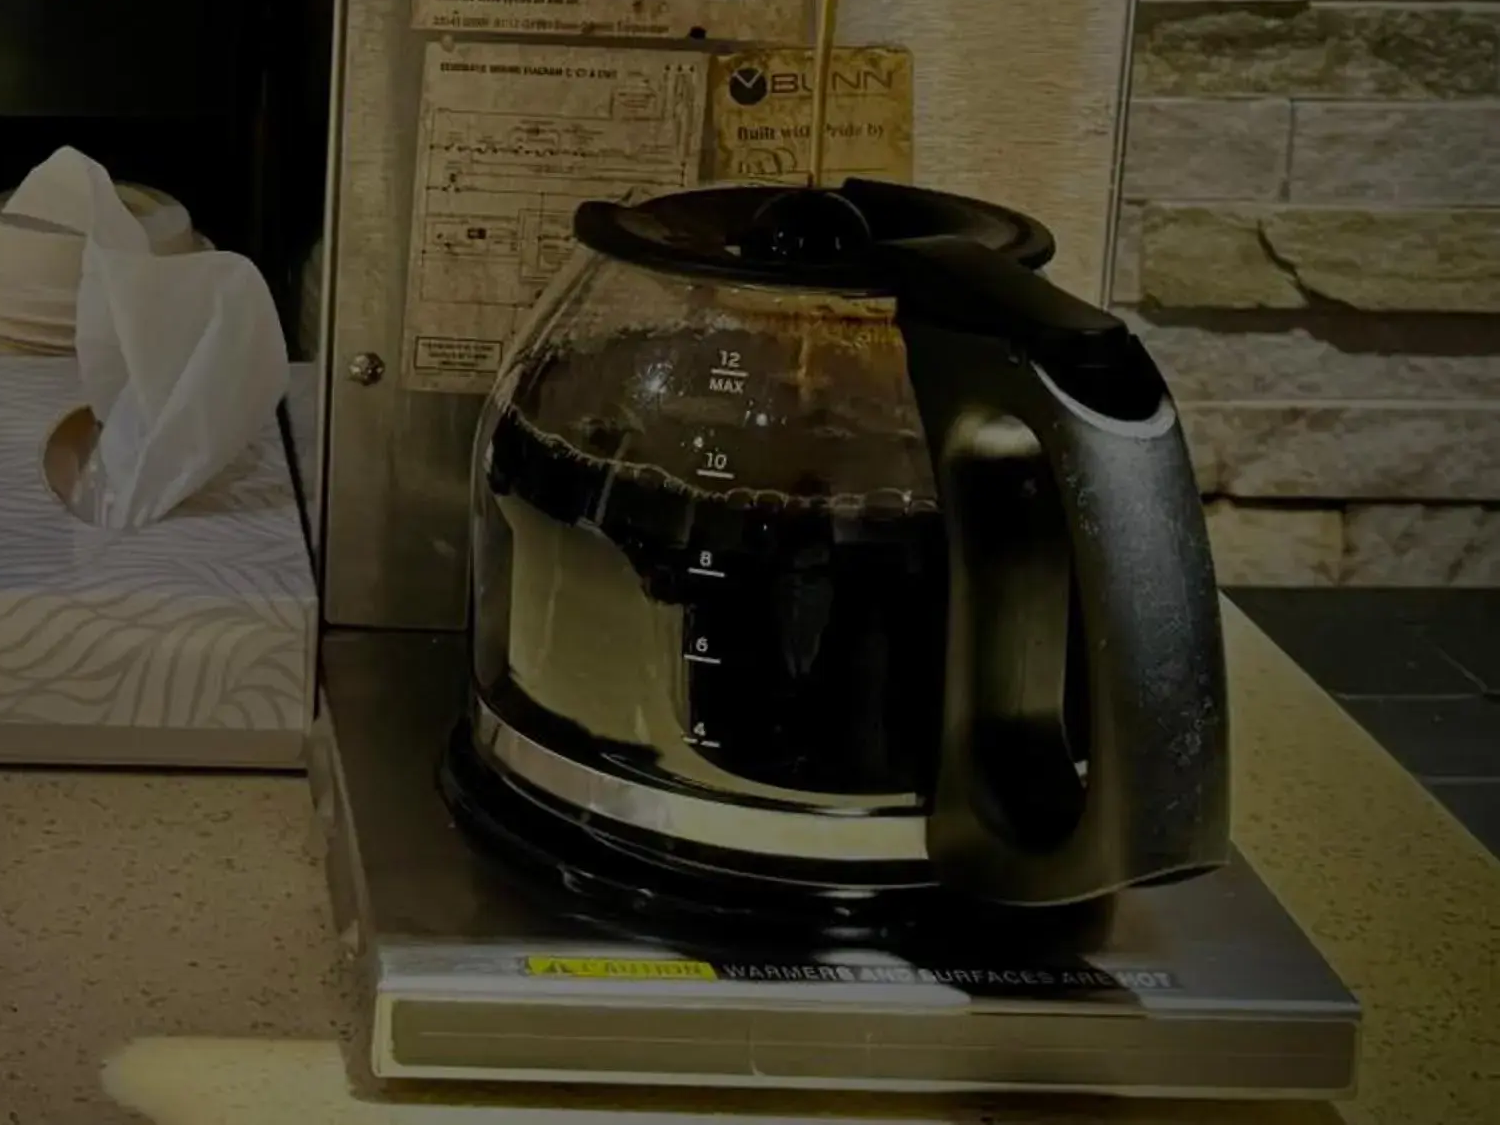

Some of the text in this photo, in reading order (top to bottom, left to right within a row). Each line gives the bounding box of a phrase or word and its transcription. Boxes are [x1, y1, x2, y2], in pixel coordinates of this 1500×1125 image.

[718, 349, 742, 369] 12
[709, 377, 744, 395] MAX
[705, 451, 728, 470] 10
[699, 549, 714, 568] 8
[696, 636, 709, 653] 6
[693, 721, 708, 738] 4
[723, 962, 855, 981] WARMERS
[1062, 969, 1116, 986] ARE
